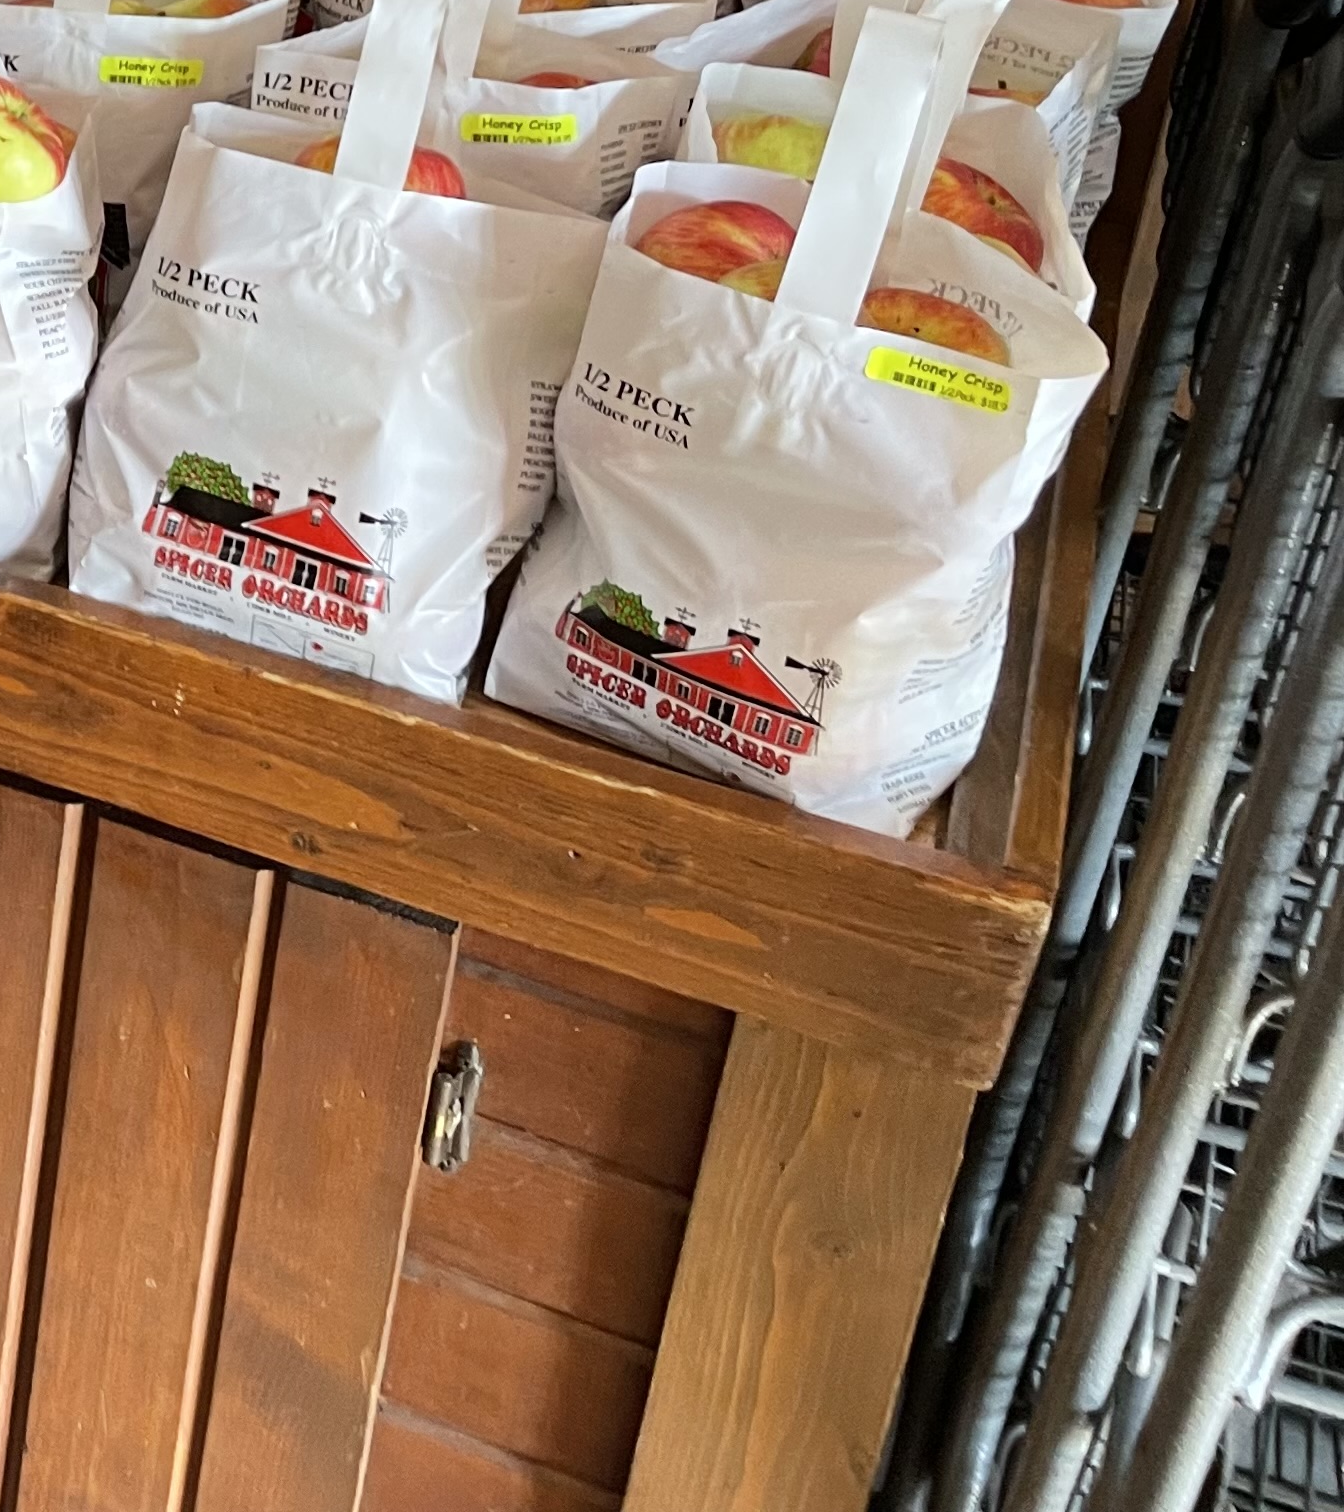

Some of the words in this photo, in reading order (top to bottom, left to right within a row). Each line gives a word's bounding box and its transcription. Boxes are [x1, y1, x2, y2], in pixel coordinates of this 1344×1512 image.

[119, 60, 155, 74] Honey
[161, 62, 190, 75] Crisp
[262, 71, 292, 91] 1/2
[256, 94, 310, 114] Produce
[314, 105, 330, 118] of
[482, 116, 523, 132] Honey
[529, 118, 562, 133] Crisp
[152, 278, 200, 310] Produce
[204, 302, 221, 315] of
[225, 304, 259, 324] USA
[158, 256, 181, 282] 1/2
[187, 268, 261, 304] PECK
[583, 362, 611, 392] 1/2
[615, 379, 695, 428] PECK
[908, 356, 958, 383] Honey
[963, 373, 1004, 396] Crisp
[575, 384, 629, 425] Produce
[632, 419, 651, 433] of
[654, 422, 689, 450] USA
[153, 545, 233, 591] SPICER
[241, 574, 368, 635] ORCHARDS
[567, 653, 647, 709] SPICER
[656, 698, 791, 776] ORCHARDS
